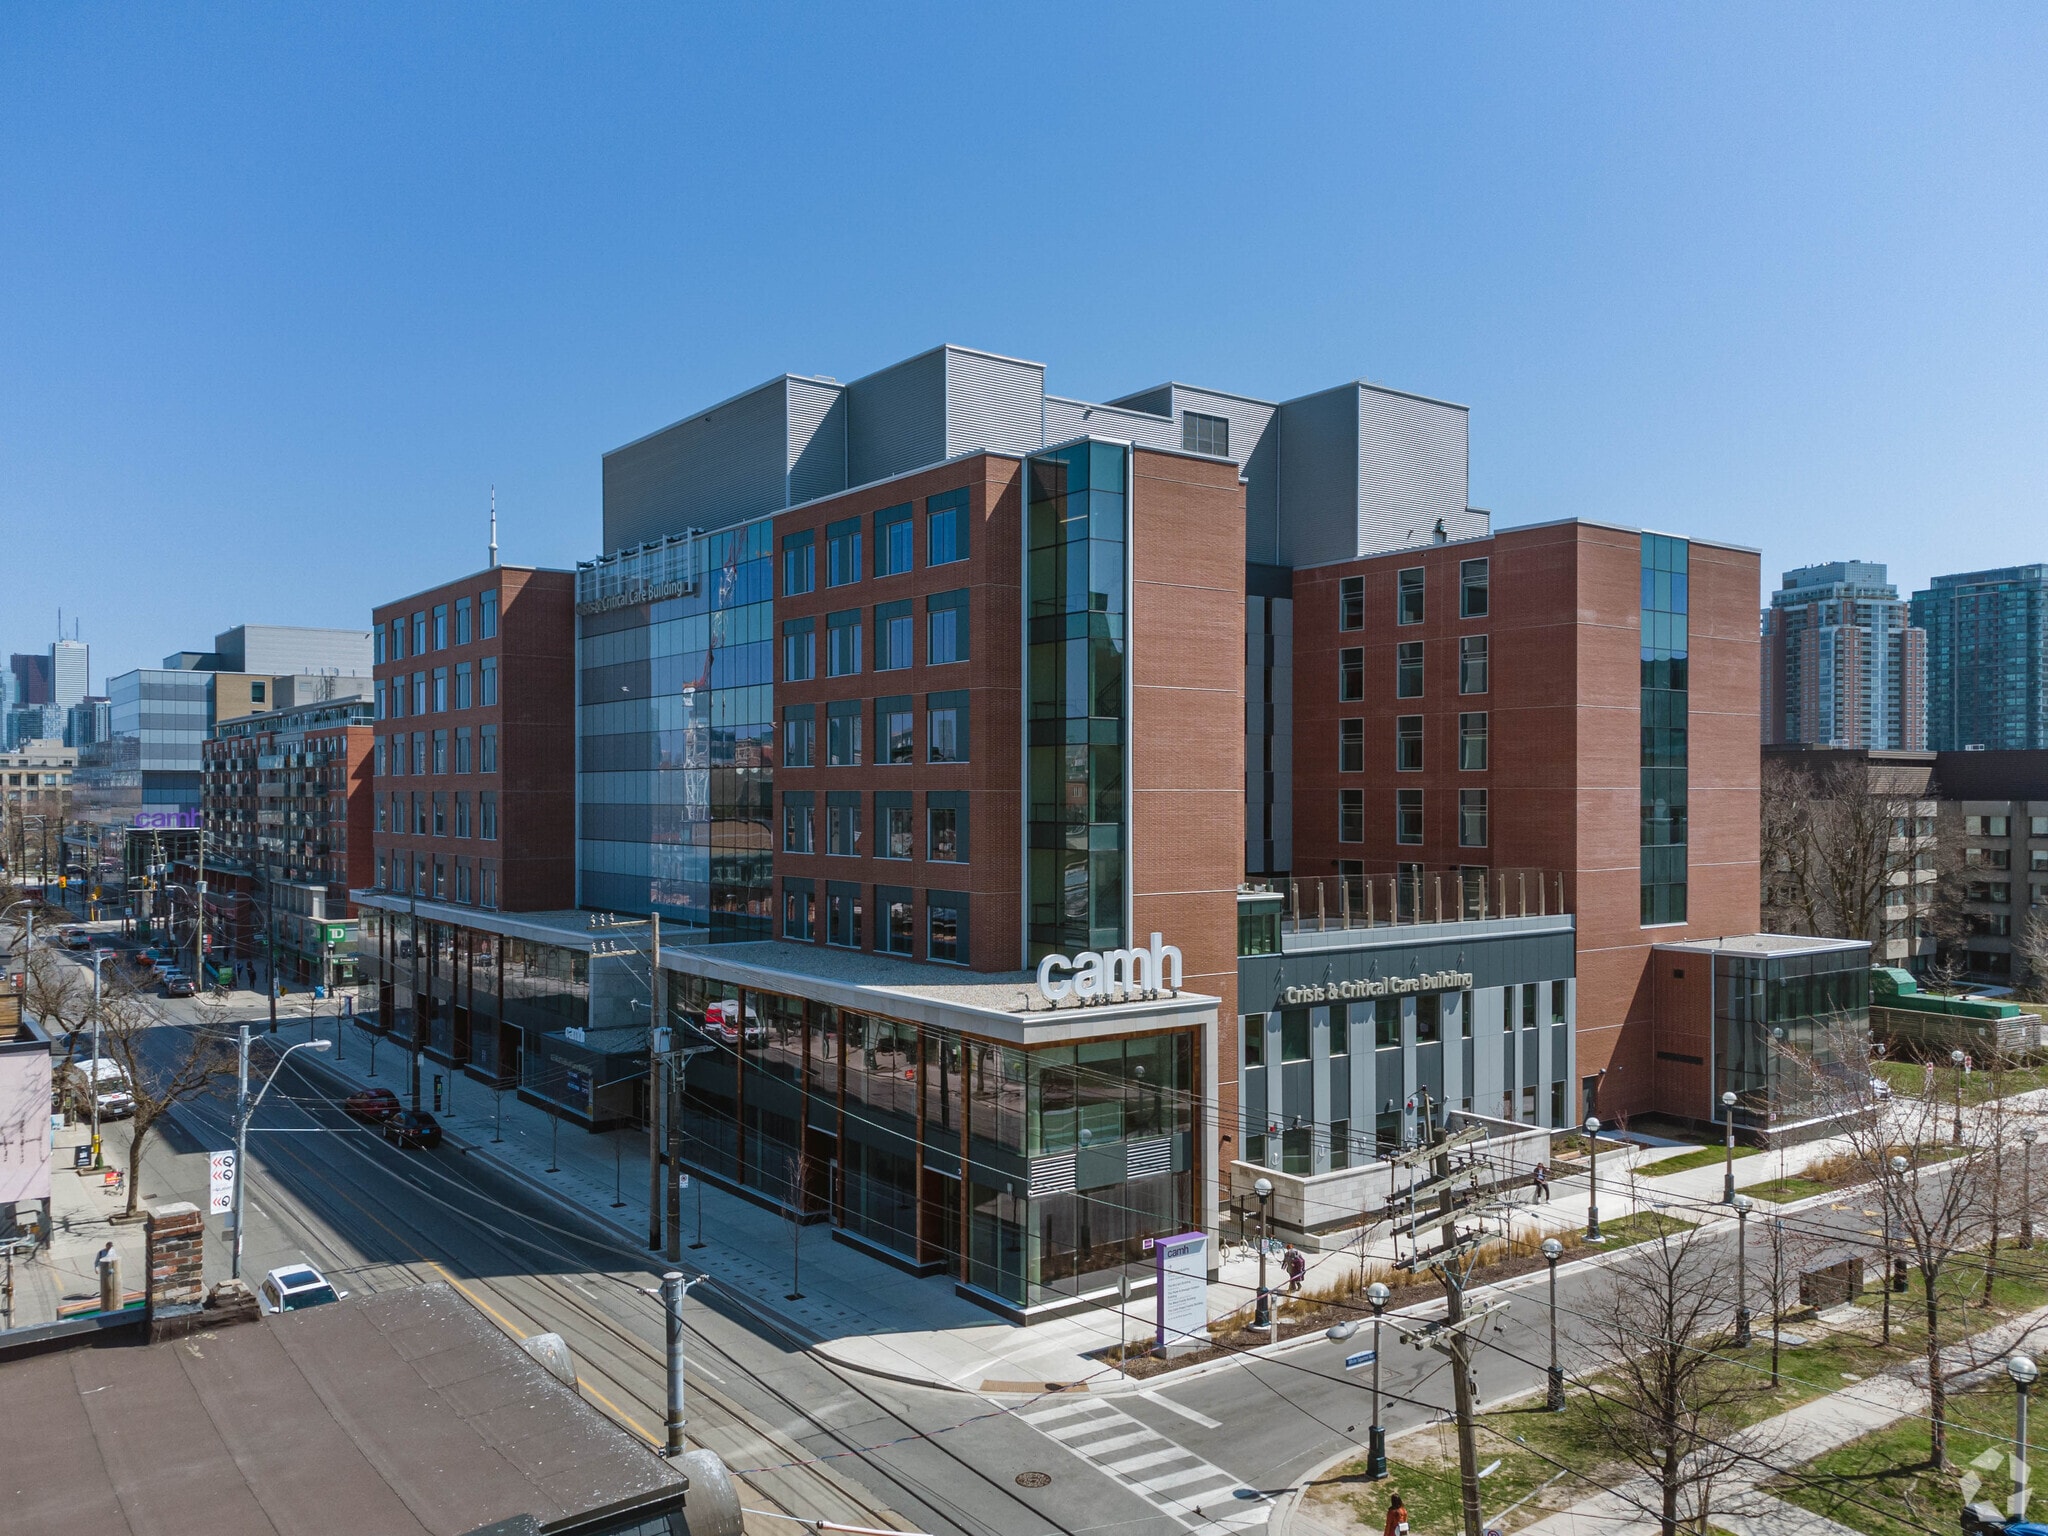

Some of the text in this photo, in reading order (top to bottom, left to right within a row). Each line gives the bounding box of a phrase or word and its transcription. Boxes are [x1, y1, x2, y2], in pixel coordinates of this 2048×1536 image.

[602, 591, 628, 611] Critical
[629, 589, 647, 605] Care
[648, 580, 682, 600] Building
[135, 807, 204, 828] camh
[328, 928, 345, 939] TD
[1037, 932, 1182, 1001] camh
[1286, 969, 1473, 1004] Crisis & Critical Care Building
[1167, 1245, 1189, 1258] camh
